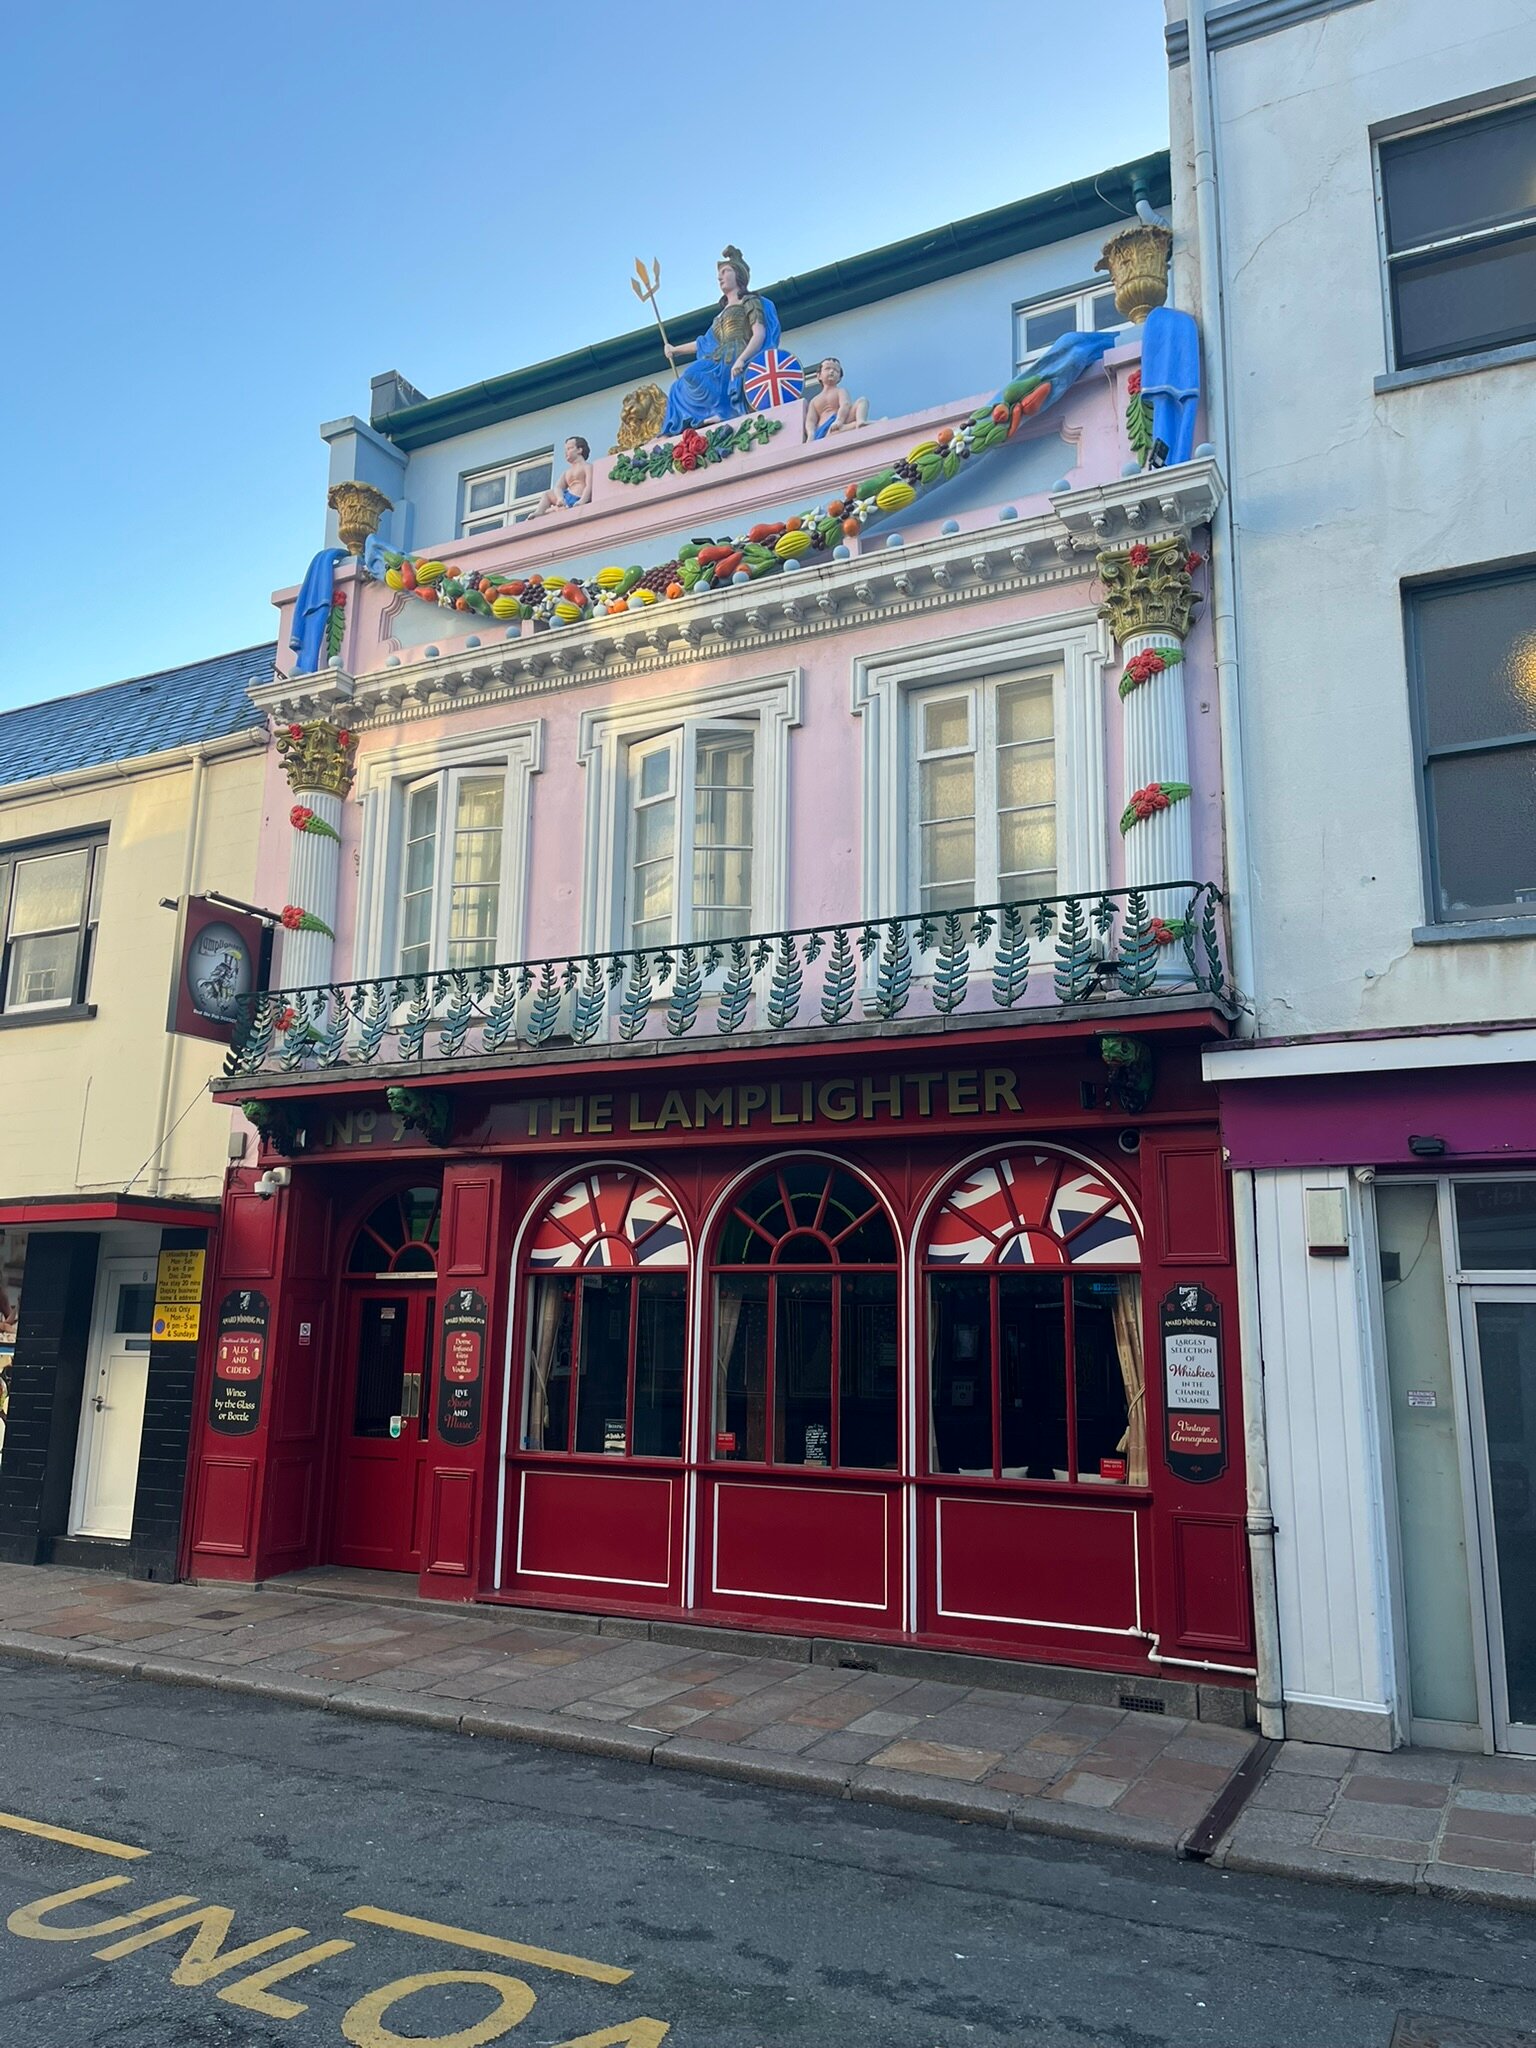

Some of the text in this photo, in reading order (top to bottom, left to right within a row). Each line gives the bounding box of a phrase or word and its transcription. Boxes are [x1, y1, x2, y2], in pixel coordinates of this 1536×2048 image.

[519, 1067, 1023, 1137] THE LAMPLIGHTER
[1165, 1319, 1182, 1327] AWARD
[1182, 1317, 1205, 1327] WINNING
[232, 1346, 248, 1356] ALES
[226, 1366, 251, 1374] CIDERS
[1169, 1364, 1215, 1378] Whiskies
[225, 1388, 246, 1397] Wines
[455, 1389, 468, 1398] LIVE
[215, 1399, 256, 1410] by the Glass
[227, 1412, 249, 1421] Bottle
[1177, 1420, 1211, 1436] Vintage
[1171, 1430, 1218, 1447] Armagnacs
